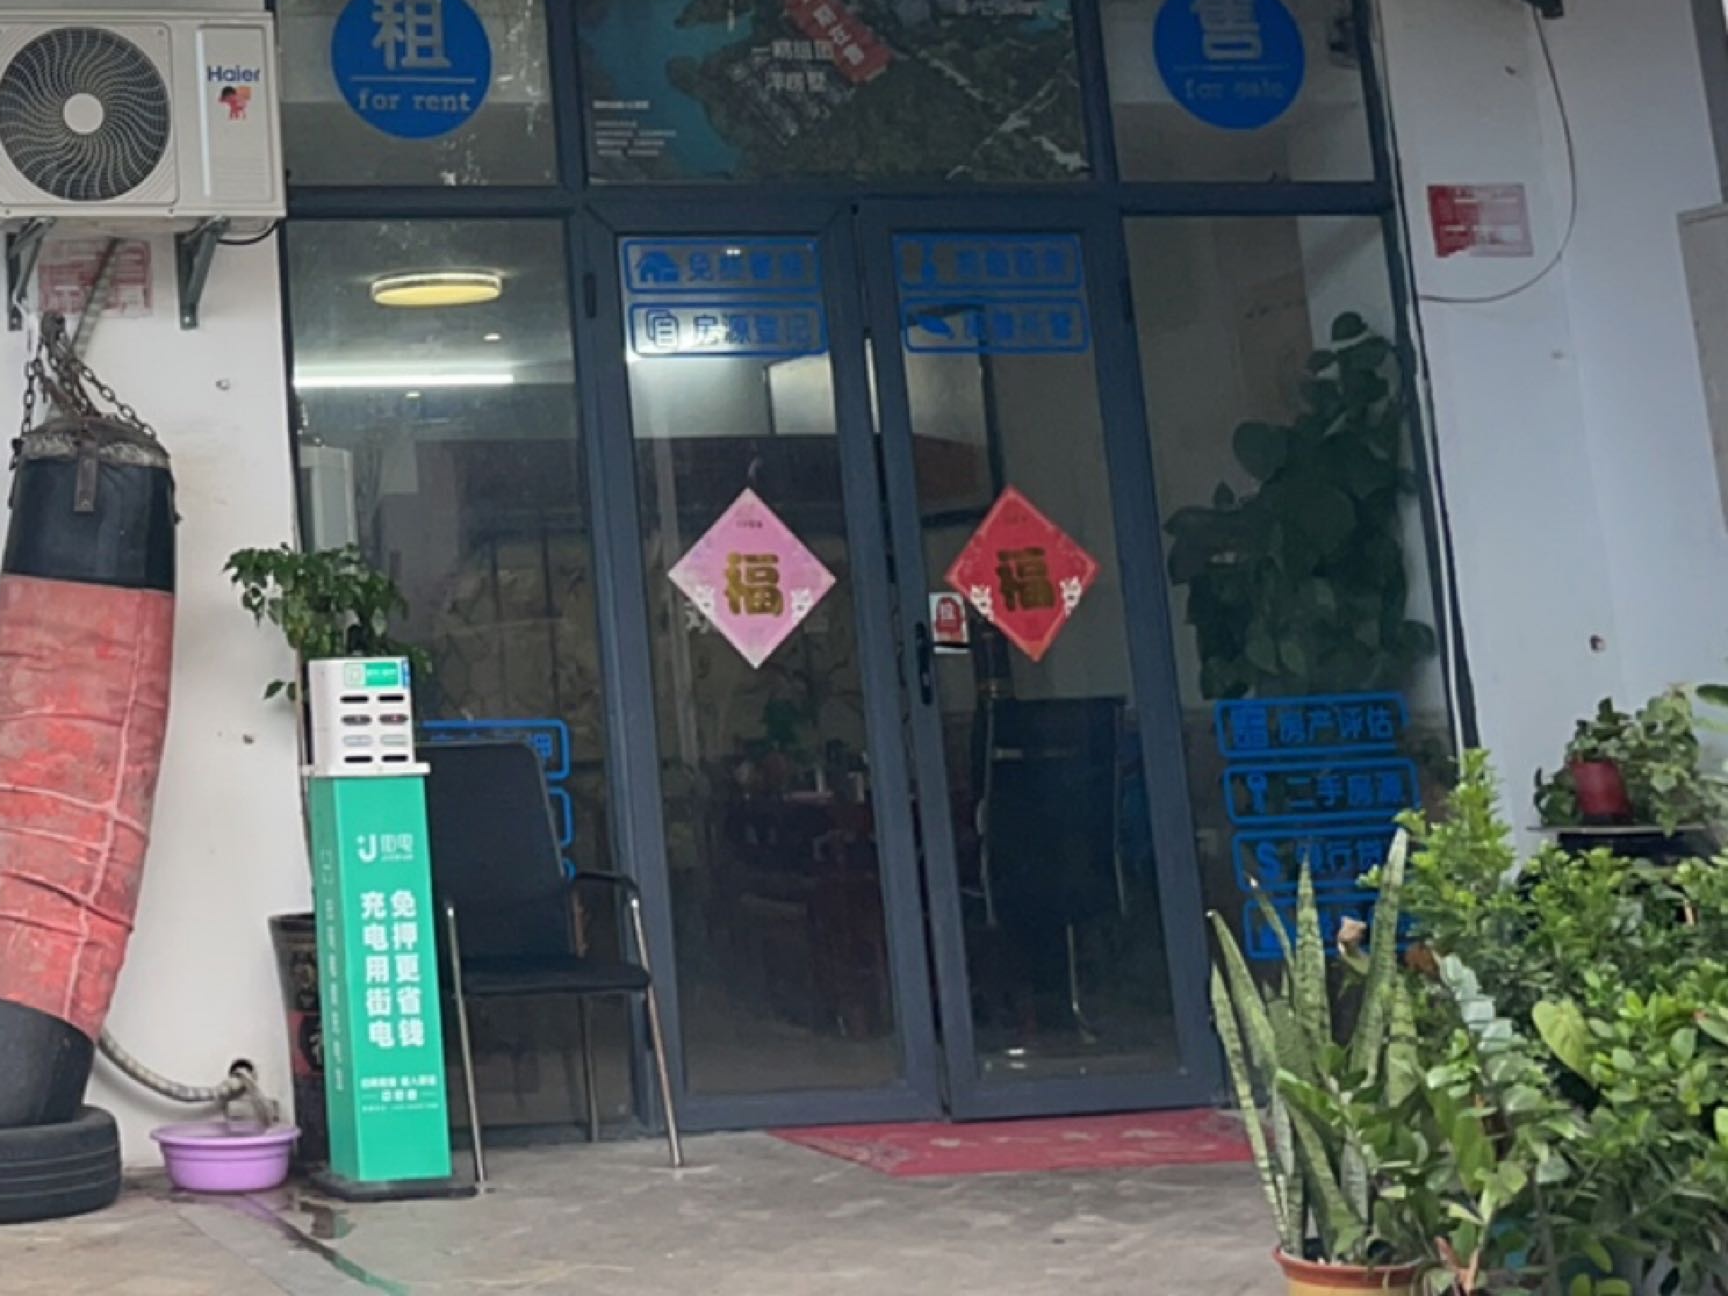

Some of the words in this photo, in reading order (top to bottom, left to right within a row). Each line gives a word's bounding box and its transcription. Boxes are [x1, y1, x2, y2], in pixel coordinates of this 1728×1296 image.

[207, 65, 261, 83] Haier
[358, 87, 400, 111] for
[412, 91, 472, 113] rent
[724, 551, 786, 618] 福
[1277, 706, 1394, 744] 房产评估
[360, 890, 395, 1048] 充电用街电
